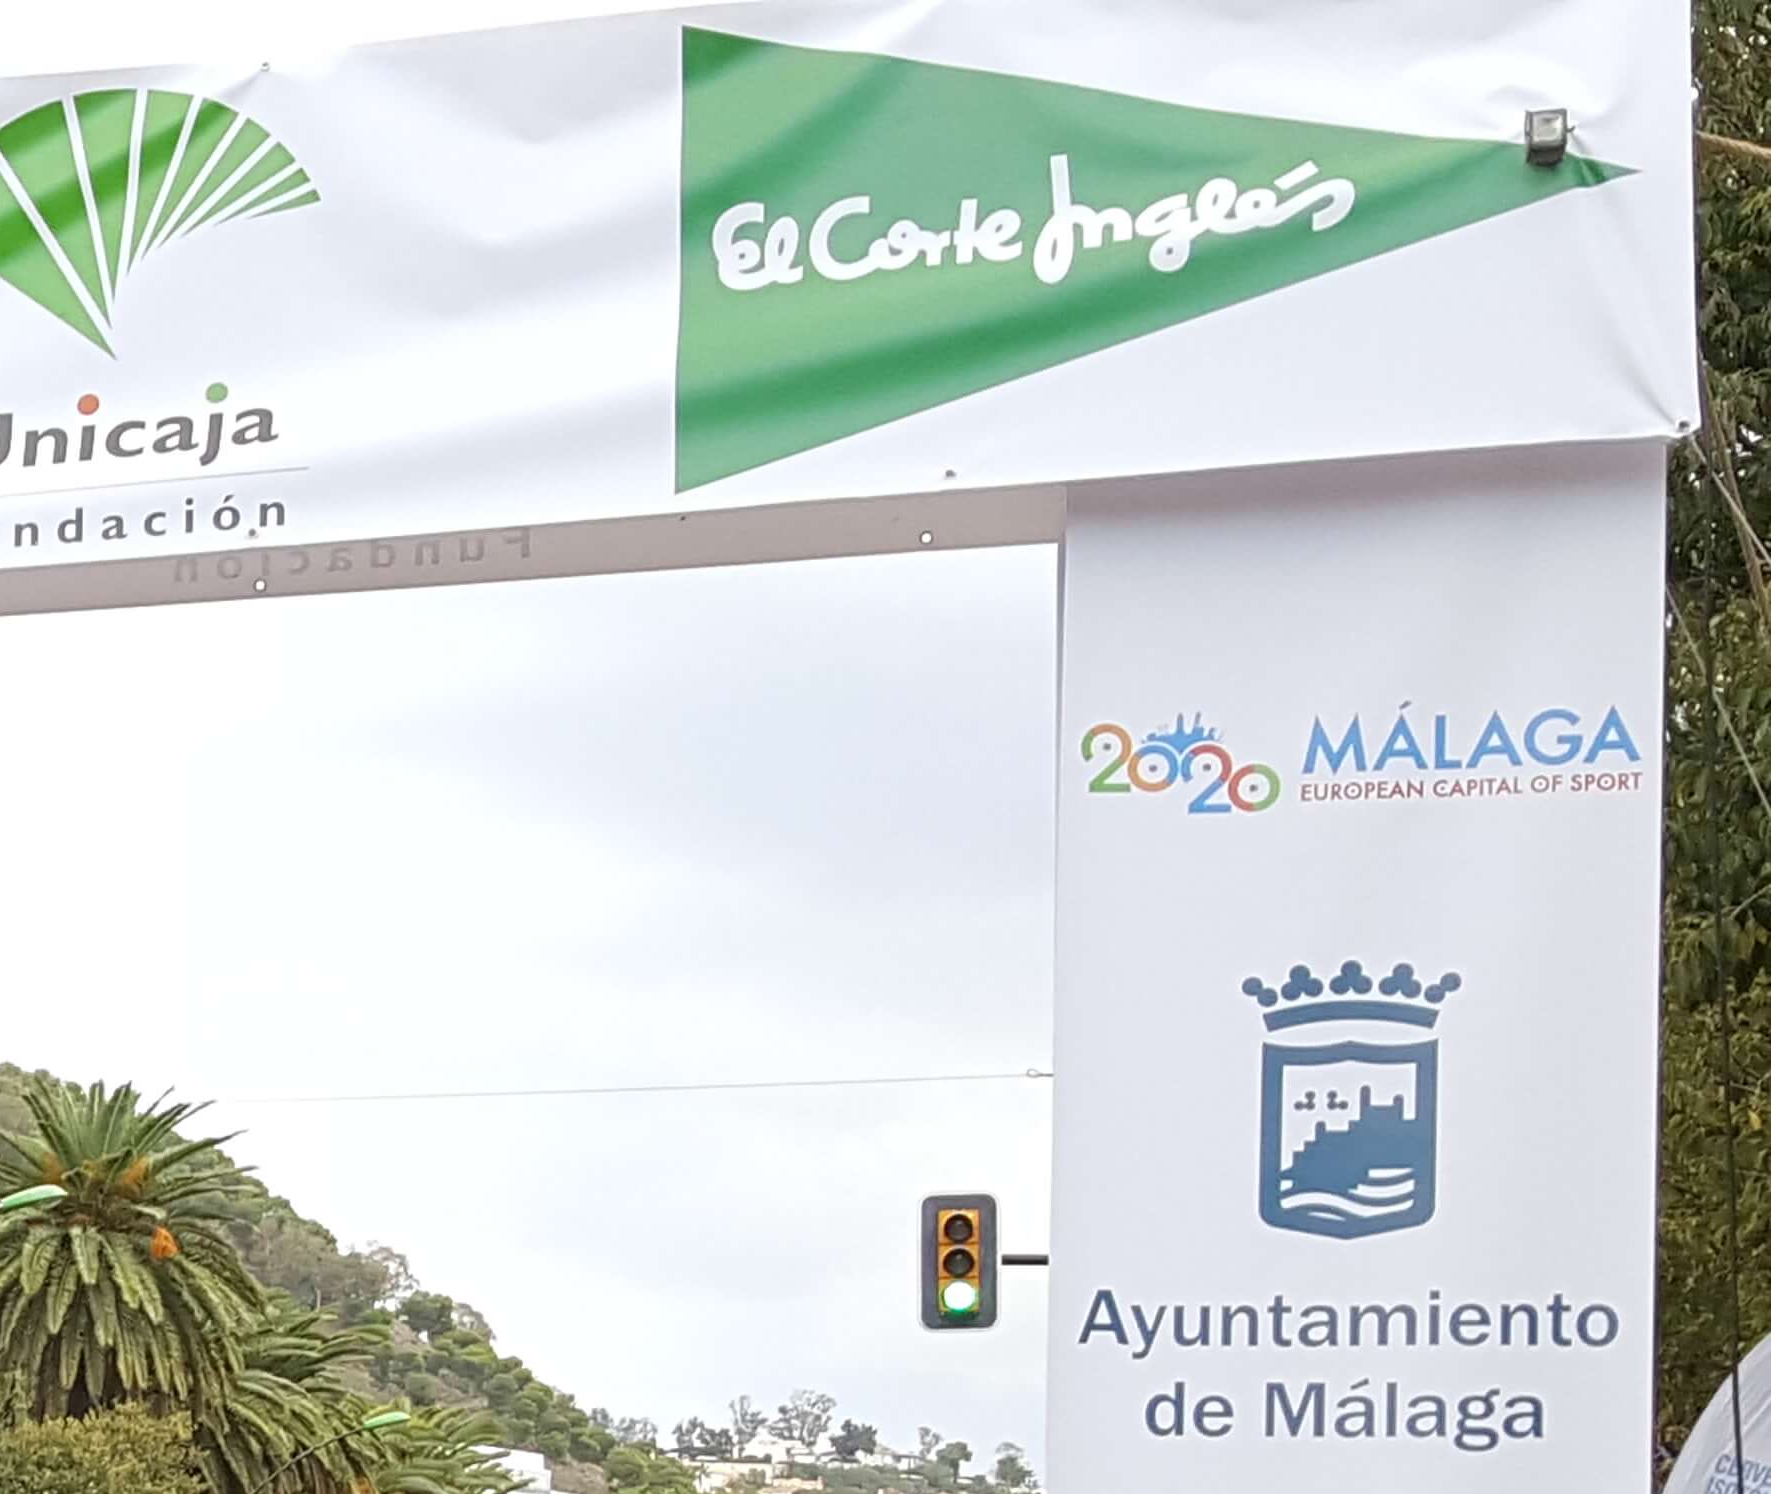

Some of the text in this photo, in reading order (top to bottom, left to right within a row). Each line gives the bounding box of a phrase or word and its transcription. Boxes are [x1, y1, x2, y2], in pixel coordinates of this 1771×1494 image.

[712, 152, 1355, 290] El Corte Inglés
[1301, 701, 1643, 775] MÁLAGA
[1300, 771, 1643, 802] EUROPEAN CAPITAL OF SPORT
[1079, 1289, 1620, 1360] Ayuntamiento
[1145, 1378, 1545, 1452] de Málaga
